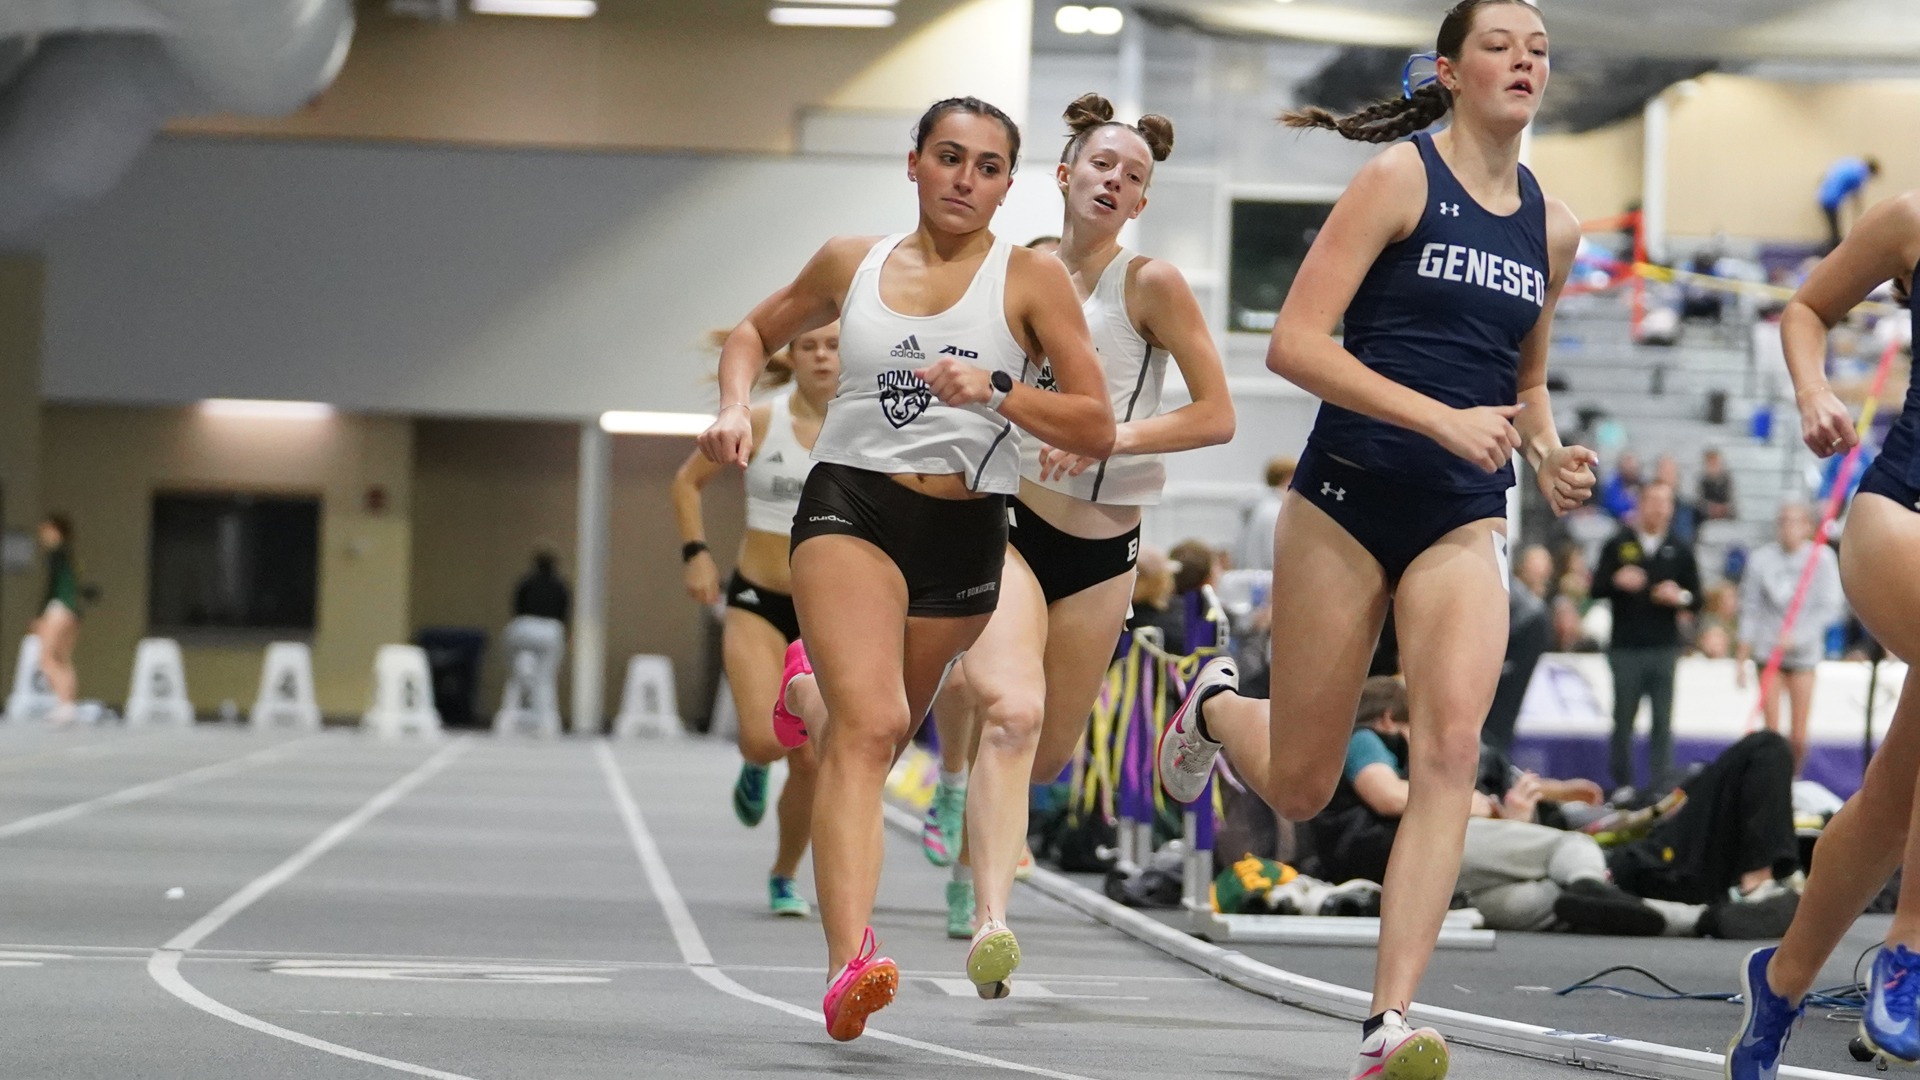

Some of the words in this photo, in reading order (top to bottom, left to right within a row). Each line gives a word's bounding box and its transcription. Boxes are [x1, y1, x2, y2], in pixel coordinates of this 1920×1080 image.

[1417, 242, 1545, 307] GENESEO
[890, 349, 926, 360] adidas
[938, 344, 979, 359] A10
[1127, 537, 1138, 562] B
